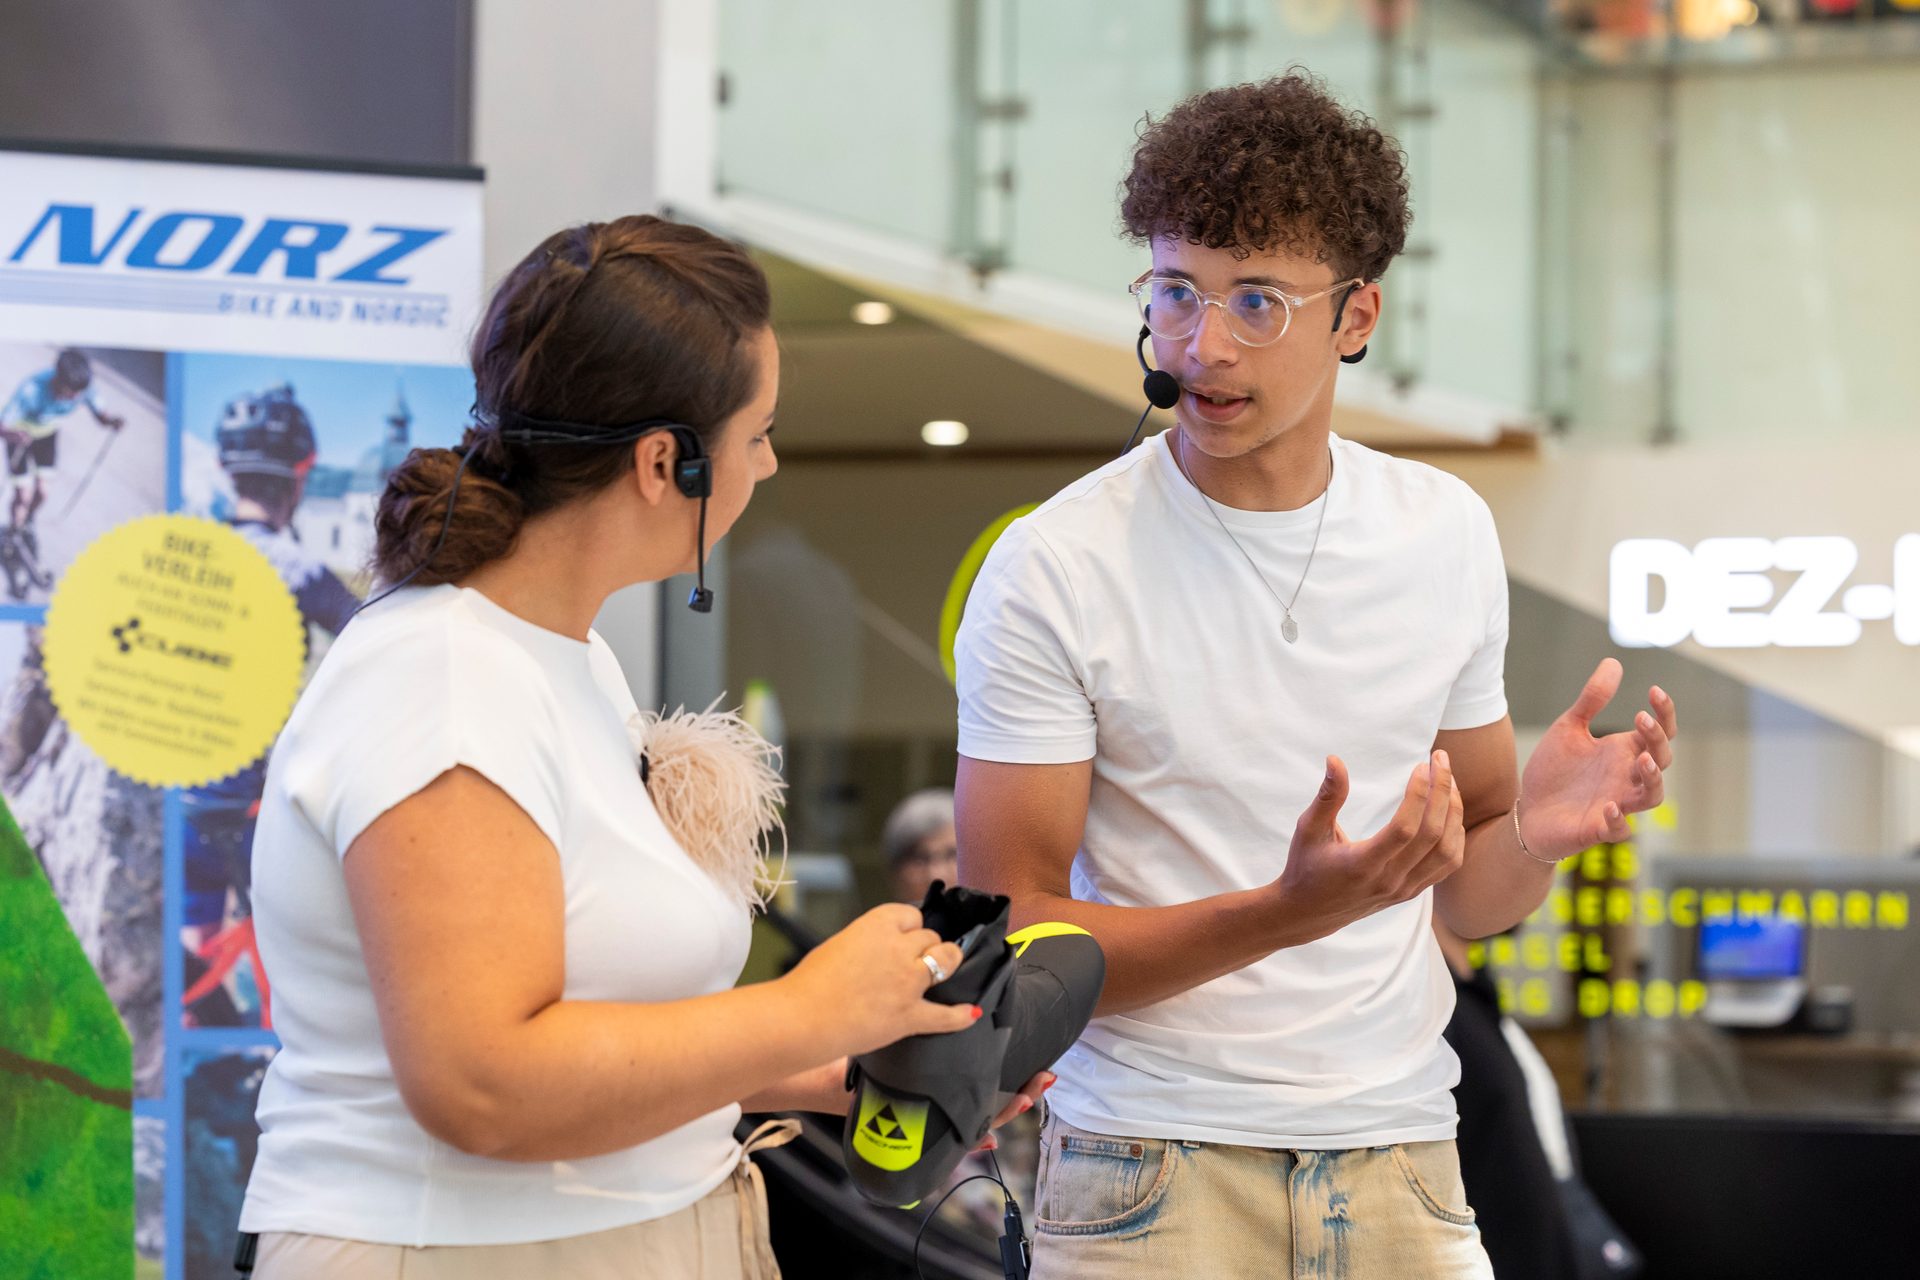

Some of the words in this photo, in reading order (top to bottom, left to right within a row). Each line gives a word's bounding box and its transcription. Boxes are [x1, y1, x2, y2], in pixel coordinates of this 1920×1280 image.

[8, 202, 451, 285] NORZ
[217, 293, 276, 319] BIKE
[288, 295, 340, 322] AND
[349, 300, 449, 327] NORDIC
[1527, 887, 1908, 929] SERSCHMARRN
